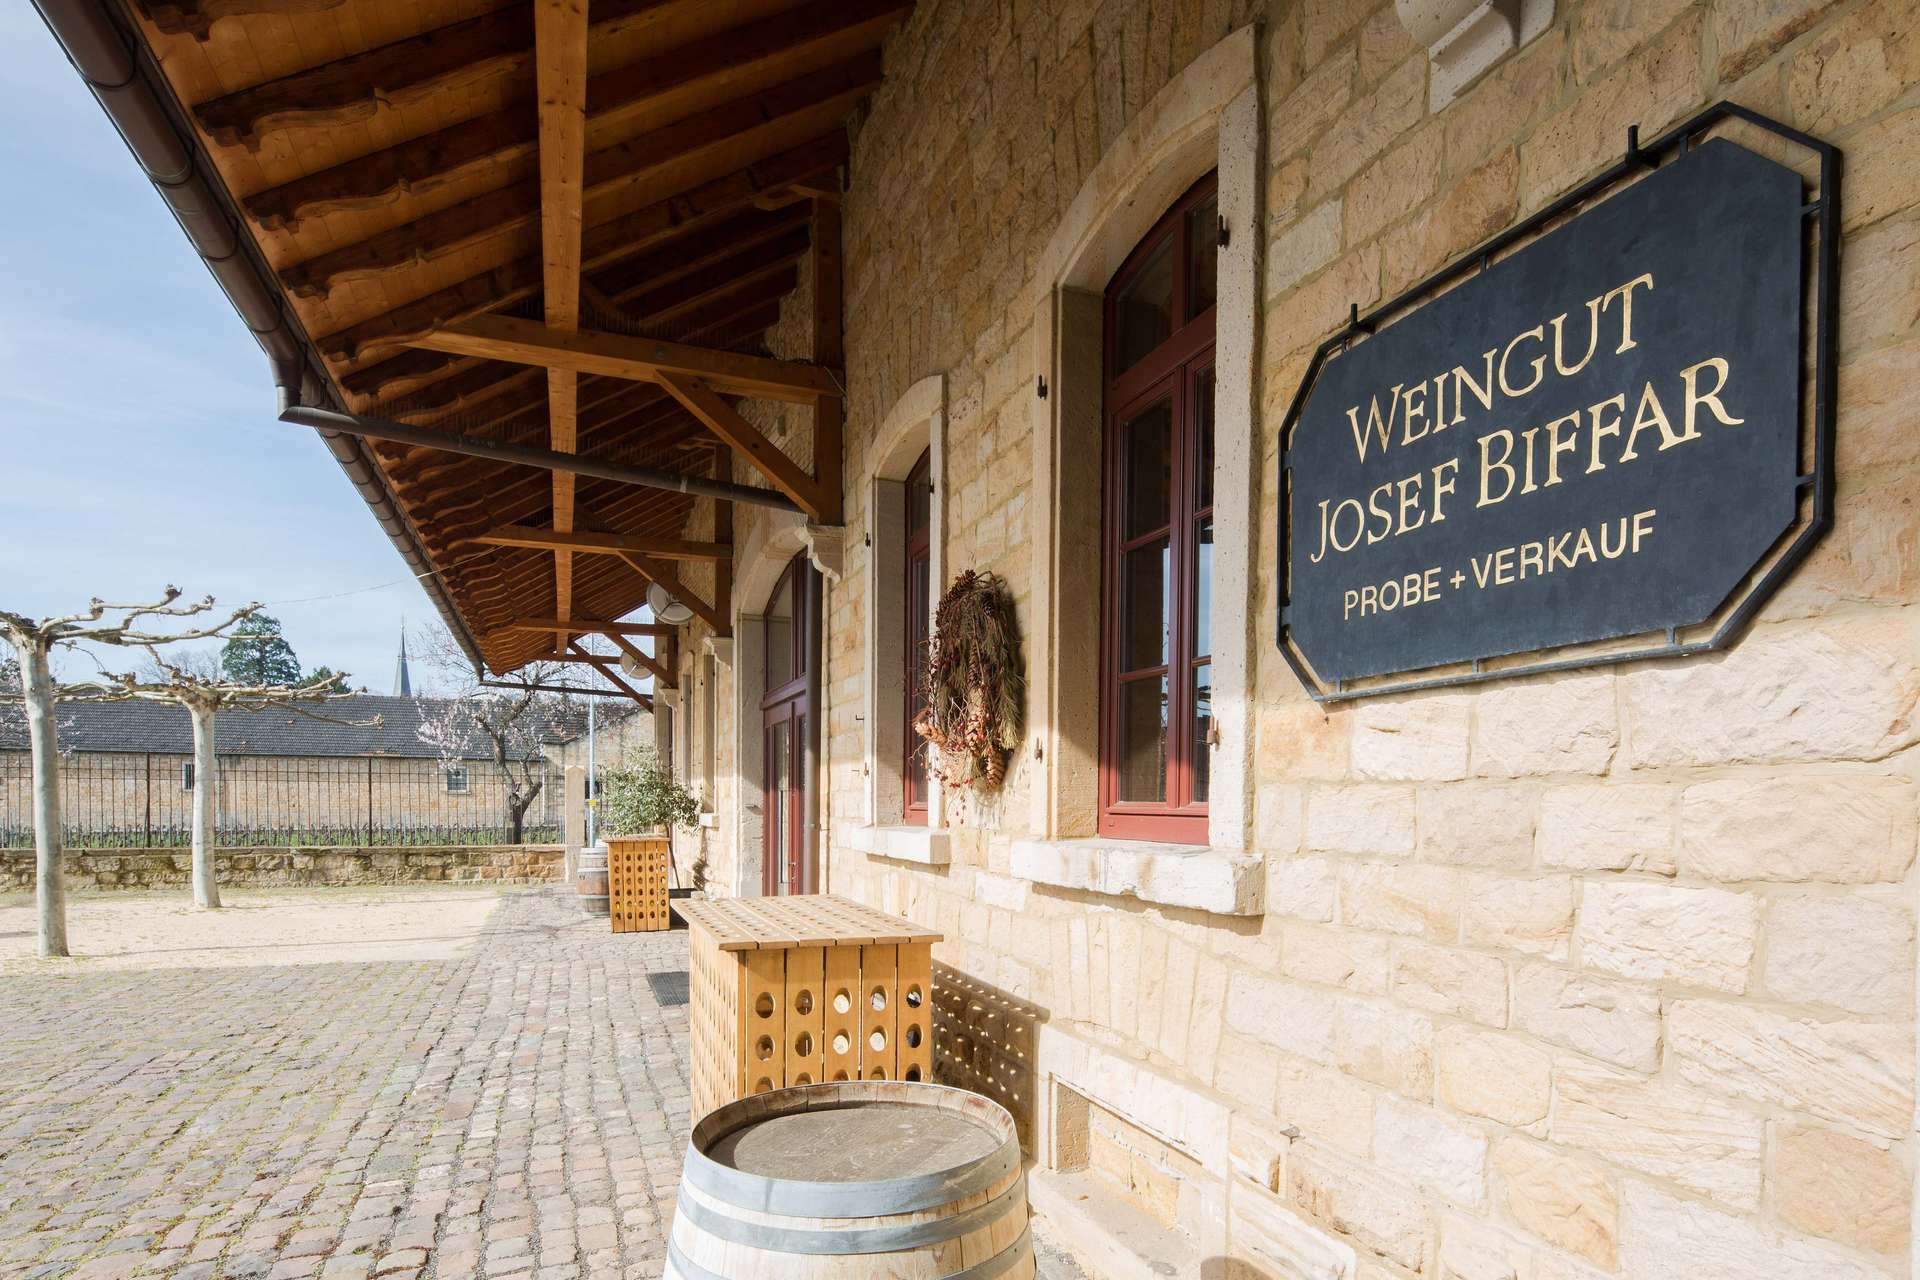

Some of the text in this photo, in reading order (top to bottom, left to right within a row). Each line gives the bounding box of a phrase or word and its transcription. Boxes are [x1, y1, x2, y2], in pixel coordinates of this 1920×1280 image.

[1310, 357, 1745, 564] JOSEF BIFFAR
[1345, 272, 1654, 464] WEINGUT
[1344, 566, 1442, 621] PROBE
[1470, 508, 1657, 589] VERKAUF
